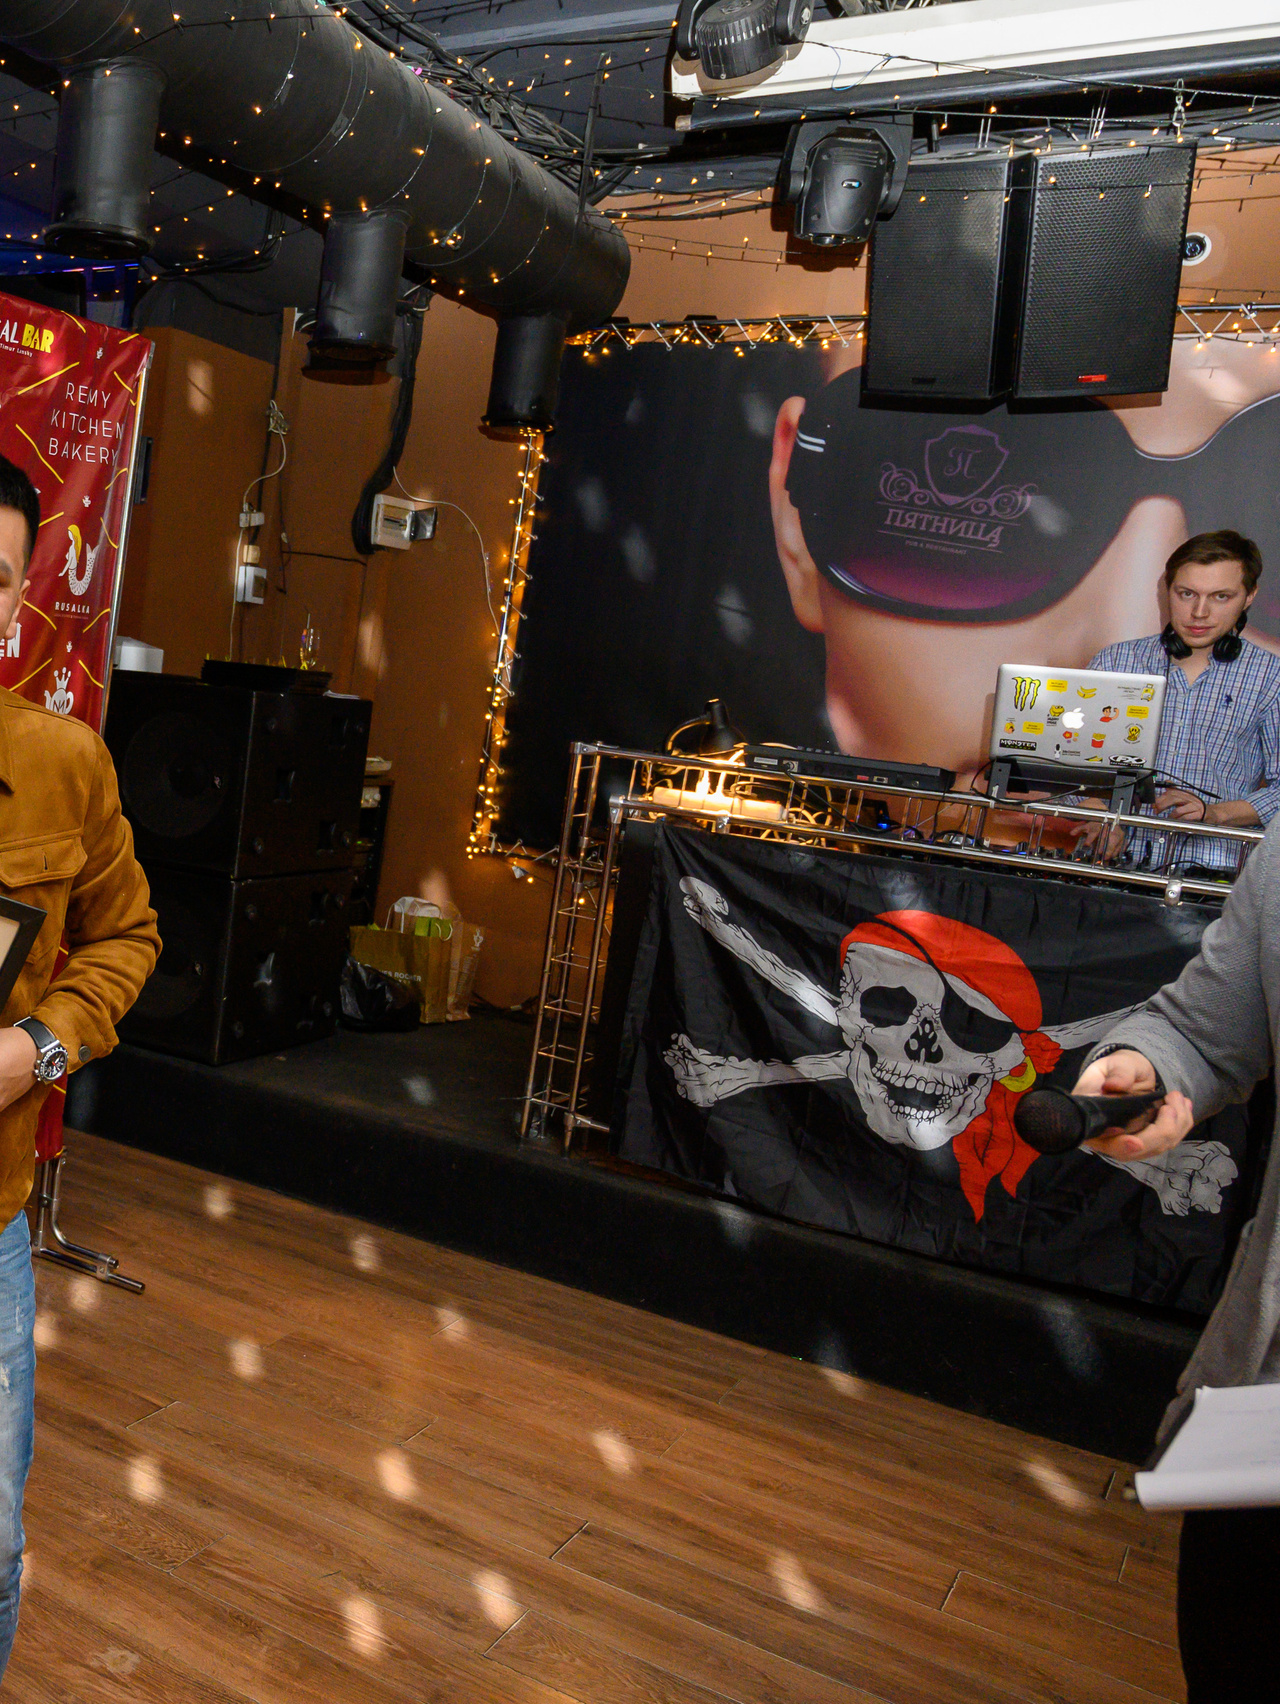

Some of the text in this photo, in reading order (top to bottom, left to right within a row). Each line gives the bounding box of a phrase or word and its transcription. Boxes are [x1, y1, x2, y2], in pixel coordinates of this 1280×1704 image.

[21, 322, 55, 354] BAR
[65, 382, 111, 409] REMY
[50, 409, 125, 441] KITCHEN
[48, 437, 120, 467] BAKERY
[883, 508, 1004, 548] ПЯТНИЦА
[55, 601, 90, 614] RUSALKA
